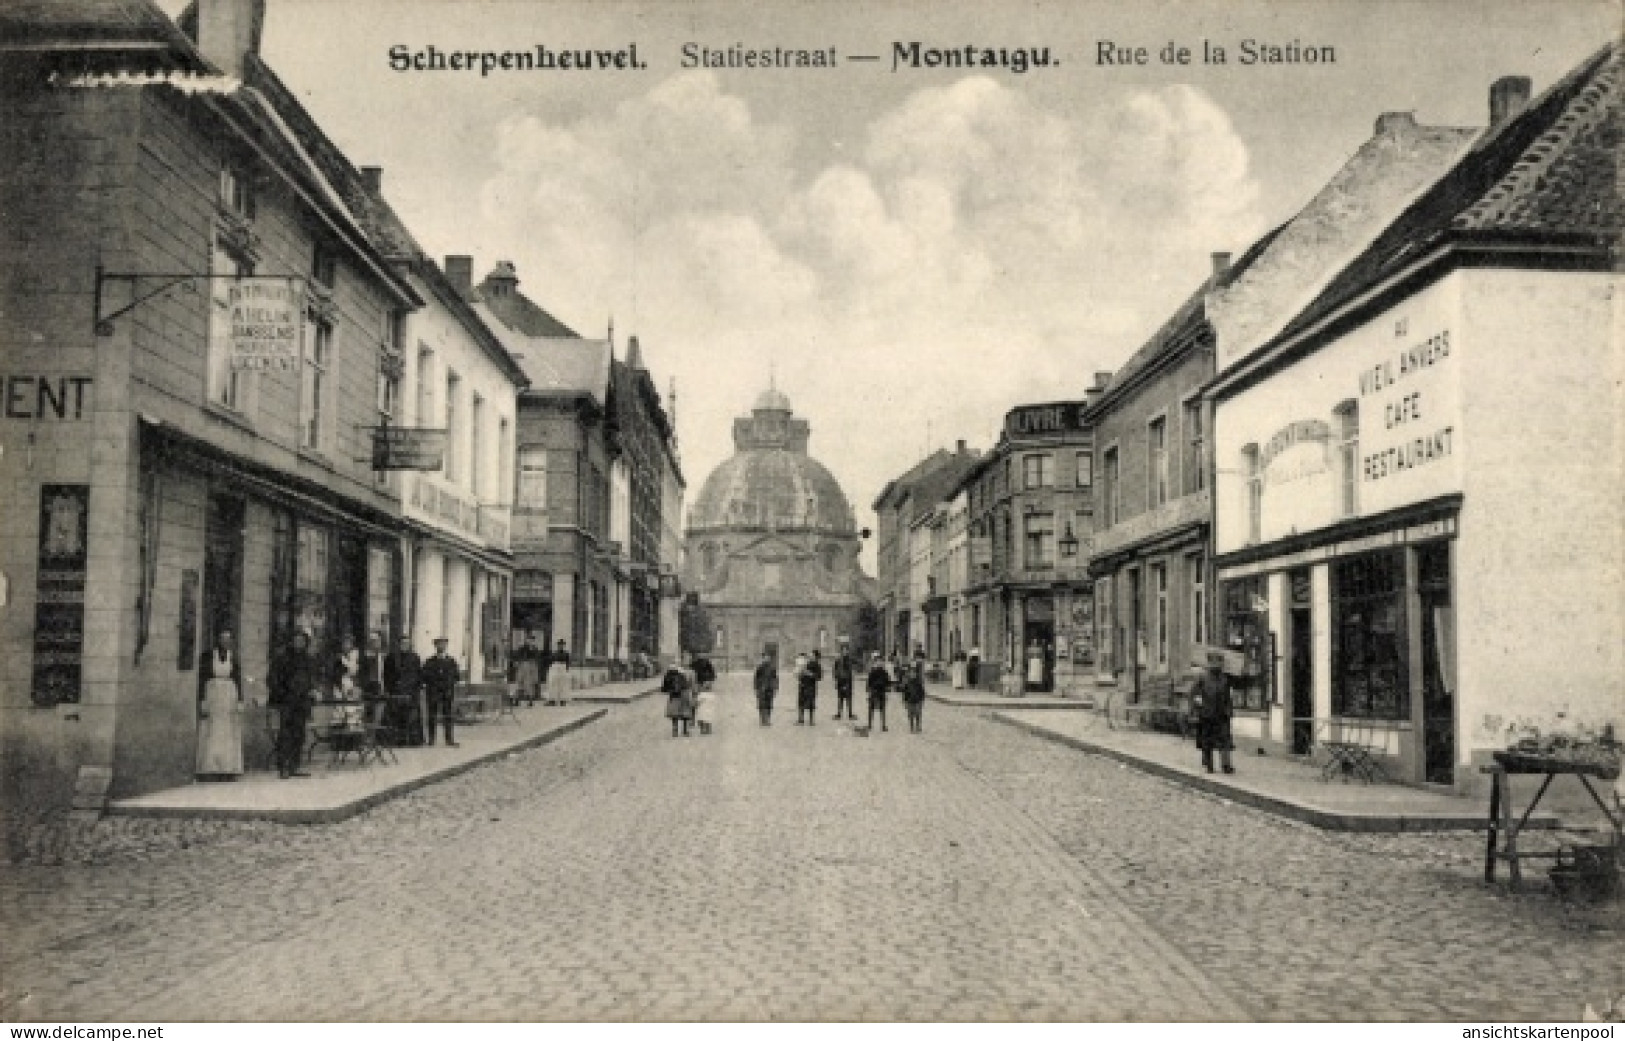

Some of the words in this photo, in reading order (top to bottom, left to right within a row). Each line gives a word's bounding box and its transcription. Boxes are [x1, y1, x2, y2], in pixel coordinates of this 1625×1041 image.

[1358, 360, 1395, 396] VIEIL
[1399, 330, 1451, 378] ANVERS
[0, 375, 93, 420] ENT
[1384, 391, 1421, 430] CAFE
[1363, 425, 1454, 483] RESTAURANT
